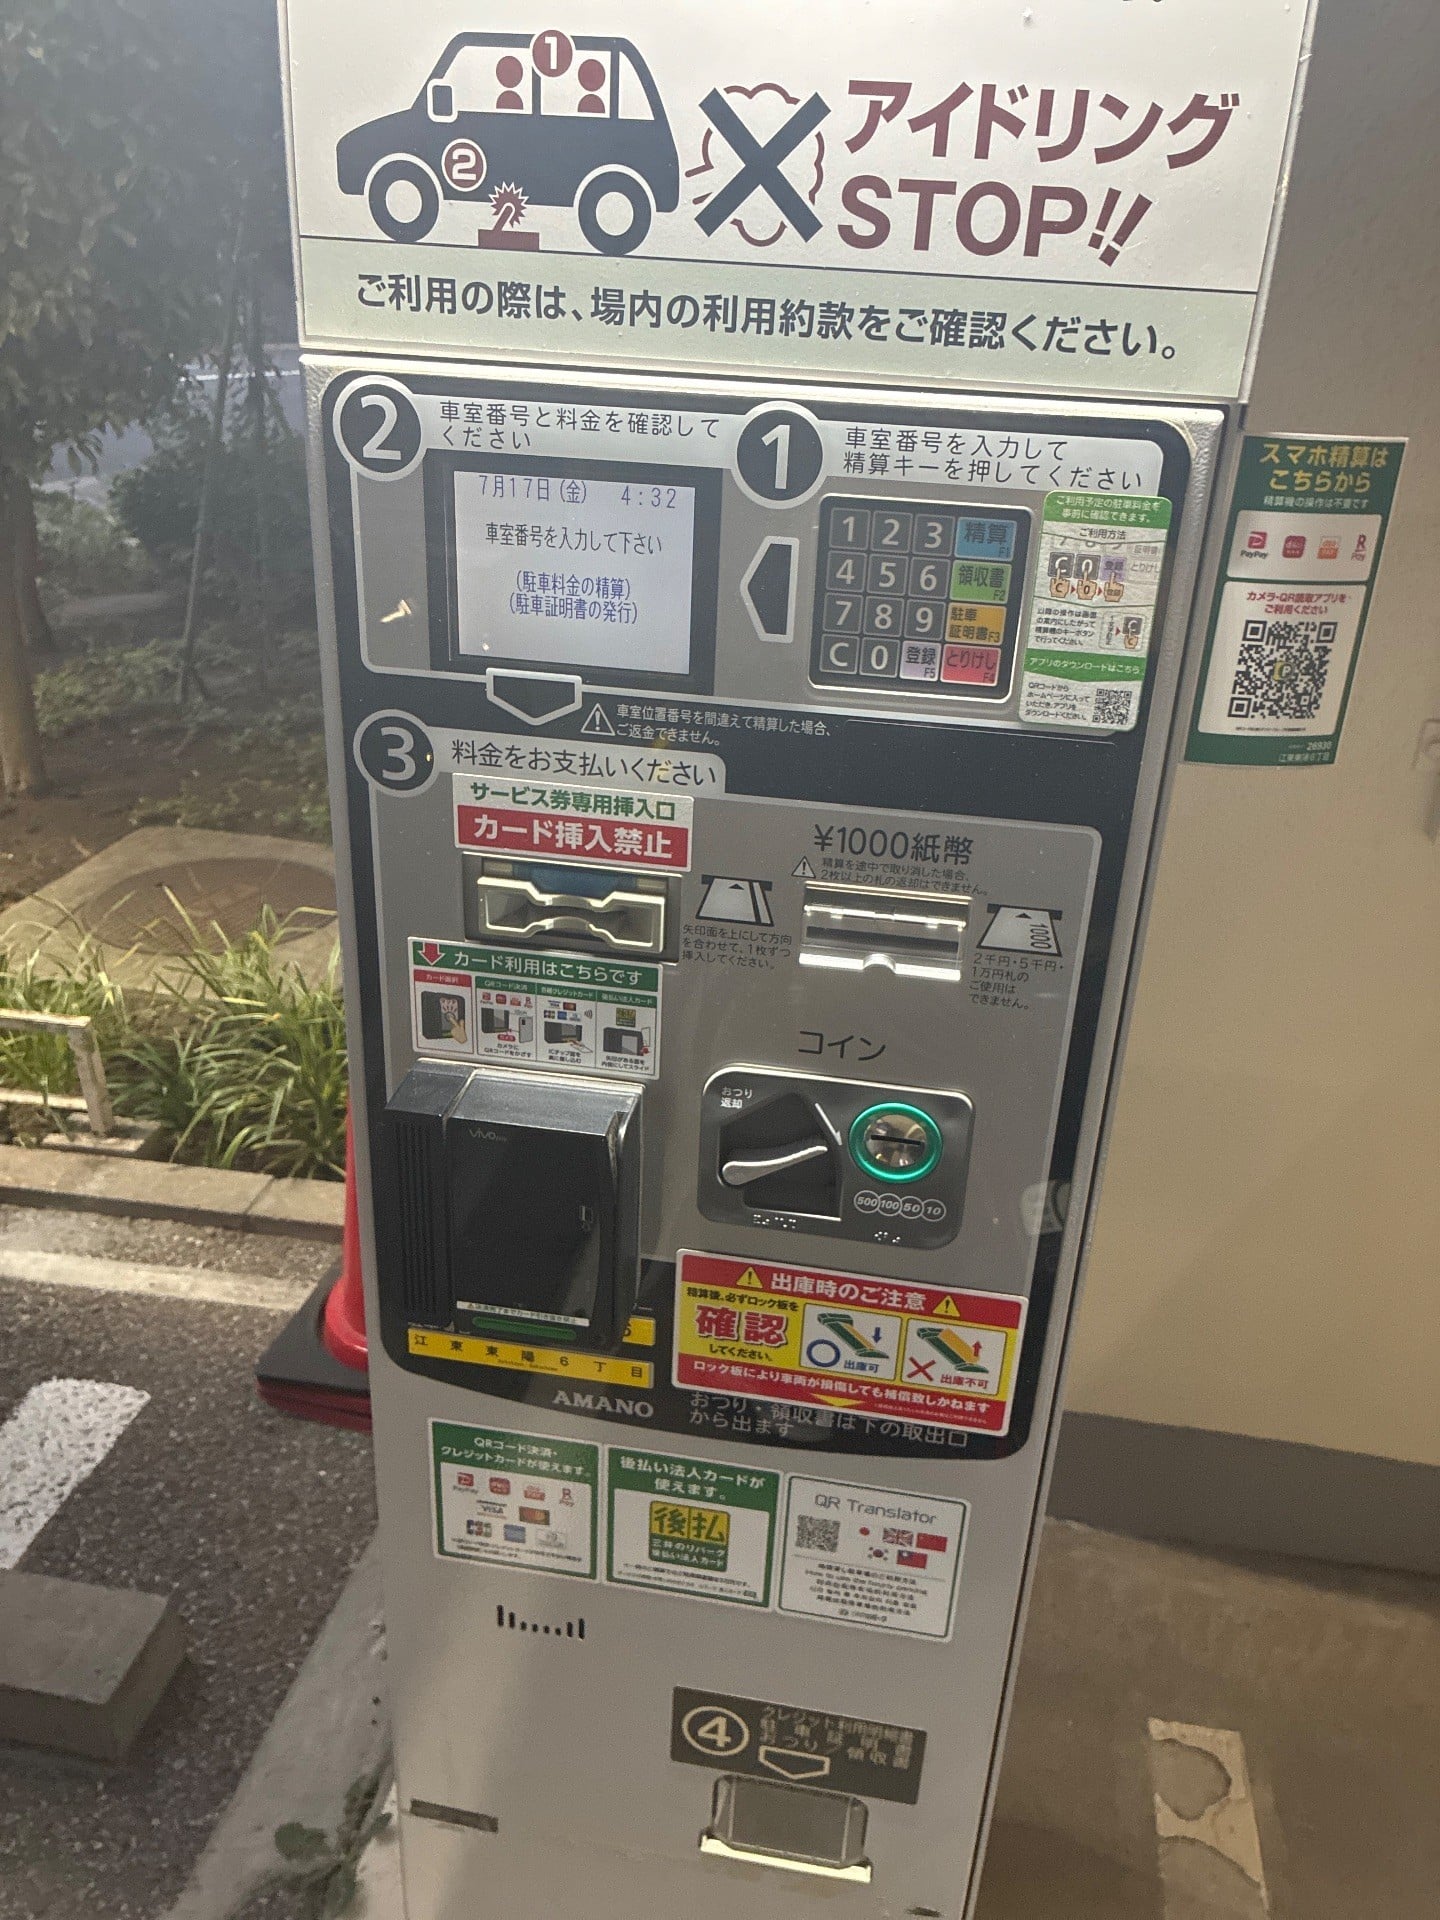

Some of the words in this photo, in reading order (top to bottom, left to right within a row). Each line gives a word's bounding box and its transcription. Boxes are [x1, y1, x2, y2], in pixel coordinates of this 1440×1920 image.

[545, 36, 562, 70] 1
[845, 78, 1241, 170] アイドリング
[451, 149, 477, 181] 2
[837, 176, 1154, 268] STOP!!
[355, 272, 1180, 362] ご利用の際は、場内の利用約款をご確認ください。
[359, 394, 402, 461] 2
[439, 400, 721, 438] 車室番号と料金を確認して
[441, 425, 532, 449] ください
[844, 427, 1070, 462] 車室番号を入力して
[761, 424, 792, 490] 1
[1259, 443, 1389, 468] スマホ精算は
[843, 451, 1142, 490] 精算キーを押してください
[1269, 469, 1372, 493] こちらから
[478, 475, 588, 504] 7月17日(金)
[621, 486, 677, 510] 4:32
[485, 522, 662, 555] 車室番号を入力して下さい
[842, 516, 854, 542] 1
[881, 518, 899, 546] 2
[924, 522, 943, 549] 3
[964, 521, 1007, 544] 精算
[1080, 528, 1127, 540] ご利用方法
[516, 569, 631, 601] (駐車料金の精算)
[835, 559, 854, 585] 4
[878, 562, 895, 588] 5
[920, 565, 937, 591] 6
[957, 565, 1005, 589] 領収書
[509, 591, 638, 625] (駐車証明書の発行)
[993, 591, 1005, 602] F2
[835, 601, 852, 626] 7
[874, 603, 892, 629] 8
[915, 607, 933, 632] 9
[950, 606, 977, 622] 駐車
[949, 624, 988, 641] 証明書
[987, 631, 1001, 643] F3
[829, 642, 849, 666] C
[871, 645, 888, 670] 0
[905, 646, 936, 666] 登録
[944, 651, 996, 671] とりけし
[1028, 657, 1141, 675] アプリのダウンロードはこちら
[924, 668, 936, 679] F5
[616, 703, 833, 738] 車室位置番号を間違えて精算した場合、
[616, 723, 721, 747] ご返金できません。
[380, 726, 416, 781] 3
[451, 739, 717, 787] 料金をお支払いください
[470, 782, 676, 821] サービス券専用挿入口
[473, 813, 673, 860] カード挿入禁止
[813, 823, 975, 866] ¥1000紙幣
[682, 924, 793, 946] 矢印面を上にして方向
[1030, 923, 1052, 949] 1000
[453, 951, 643, 985] カード利用はこちらです
[797, 1030, 886, 1062] コイン
[720, 1098, 742, 1110] 返却
[721, 1087, 753, 1098] おつり
[857, 1195, 878, 1208] 500
[880, 1198, 899, 1211] 100
[902, 1202, 921, 1216] 50
[926, 1204, 941, 1217] 10
[770, 1272, 927, 1312] 出庫時のご注意
[695, 1304, 787, 1348] 確認
[843, 1359, 880, 1374] 出庫可
[940, 1374, 988, 1390] 出庫不可
[551, 1390, 654, 1418] AMANO
[690, 1411, 794, 1437] から出ます
[620, 1455, 766, 1489] 後払い法人カードが
[814, 1493, 841, 1509] QR
[847, 1498, 938, 1524] Translator
[653, 1506, 728, 1544] 後払
[698, 1715, 731, 1748] 4
